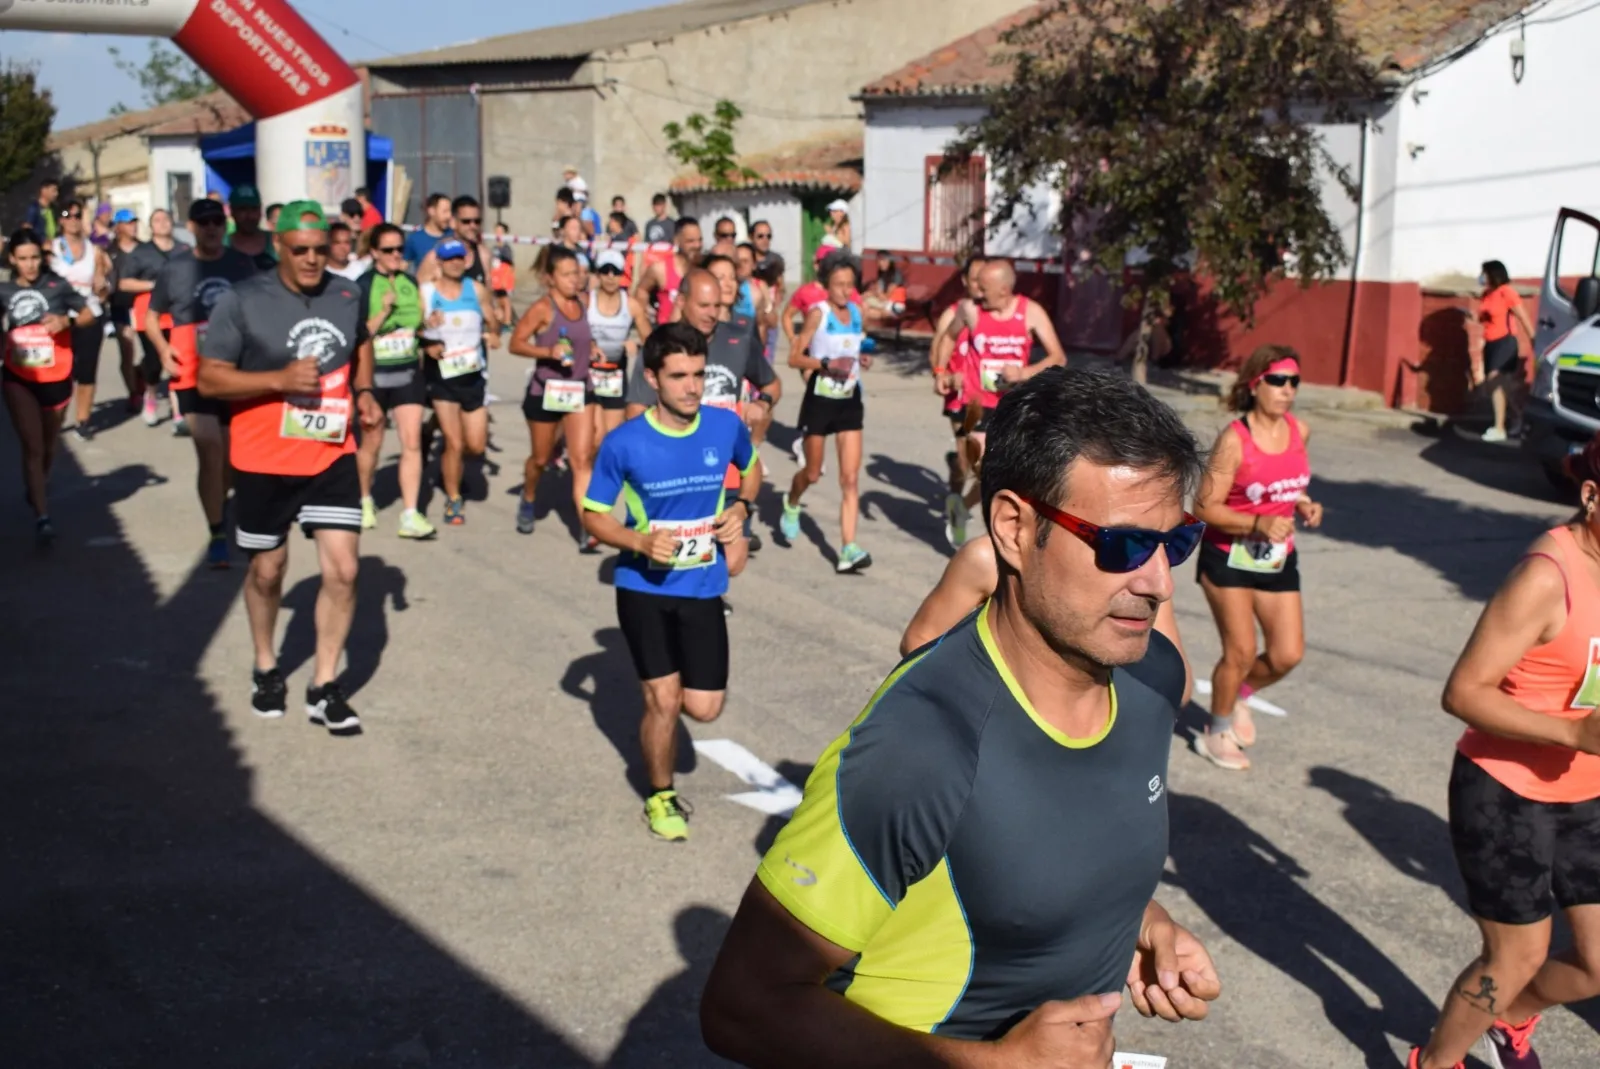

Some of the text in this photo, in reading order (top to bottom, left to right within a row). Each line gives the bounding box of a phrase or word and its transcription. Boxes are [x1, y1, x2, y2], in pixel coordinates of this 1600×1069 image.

[210, 0, 311, 97] DEPORTISTAS
[253, 8, 331, 87] NUESTROS
[303, 414, 326, 430] 70
